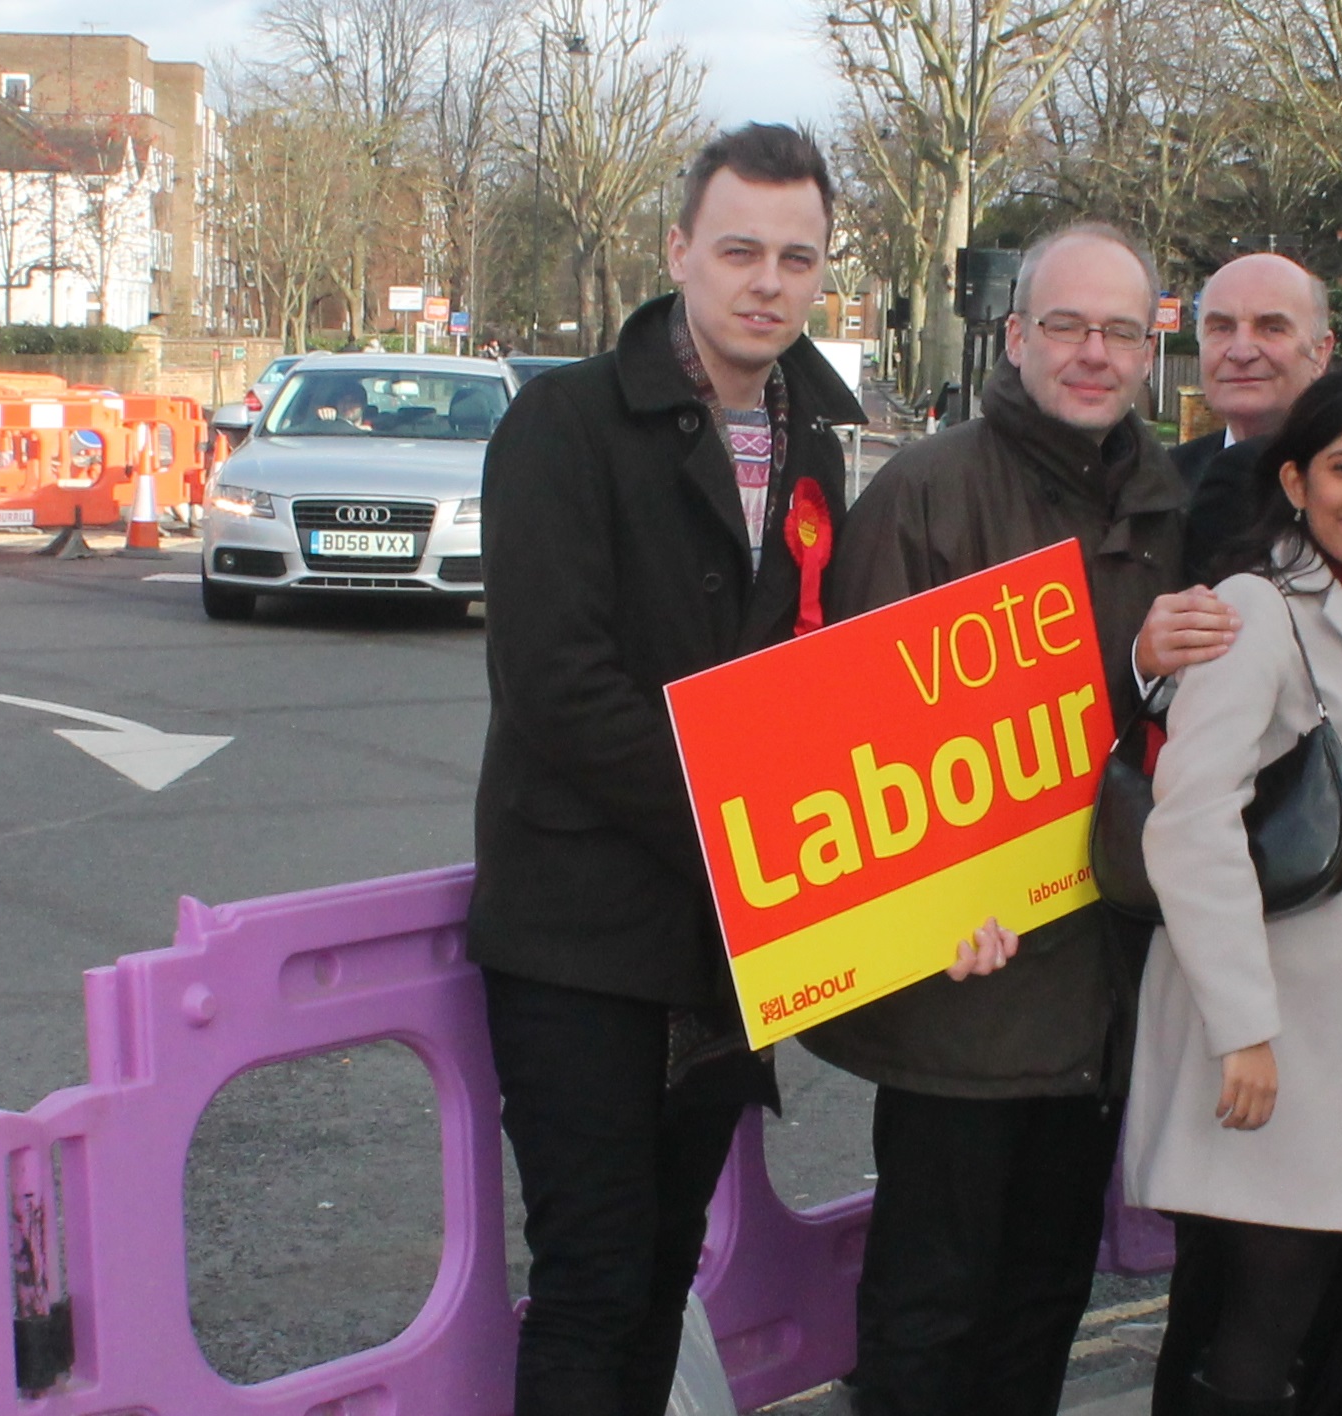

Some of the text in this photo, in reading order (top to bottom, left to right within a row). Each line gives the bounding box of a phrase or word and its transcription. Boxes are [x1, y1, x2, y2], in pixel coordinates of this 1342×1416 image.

[322, 534, 410, 552] BD58 VXX
[896, 582, 1081, 705] vote
[720, 683, 1096, 909] Labour
[1028, 866, 1091, 905] labour.or
[779, 968, 856, 1017] Labour
